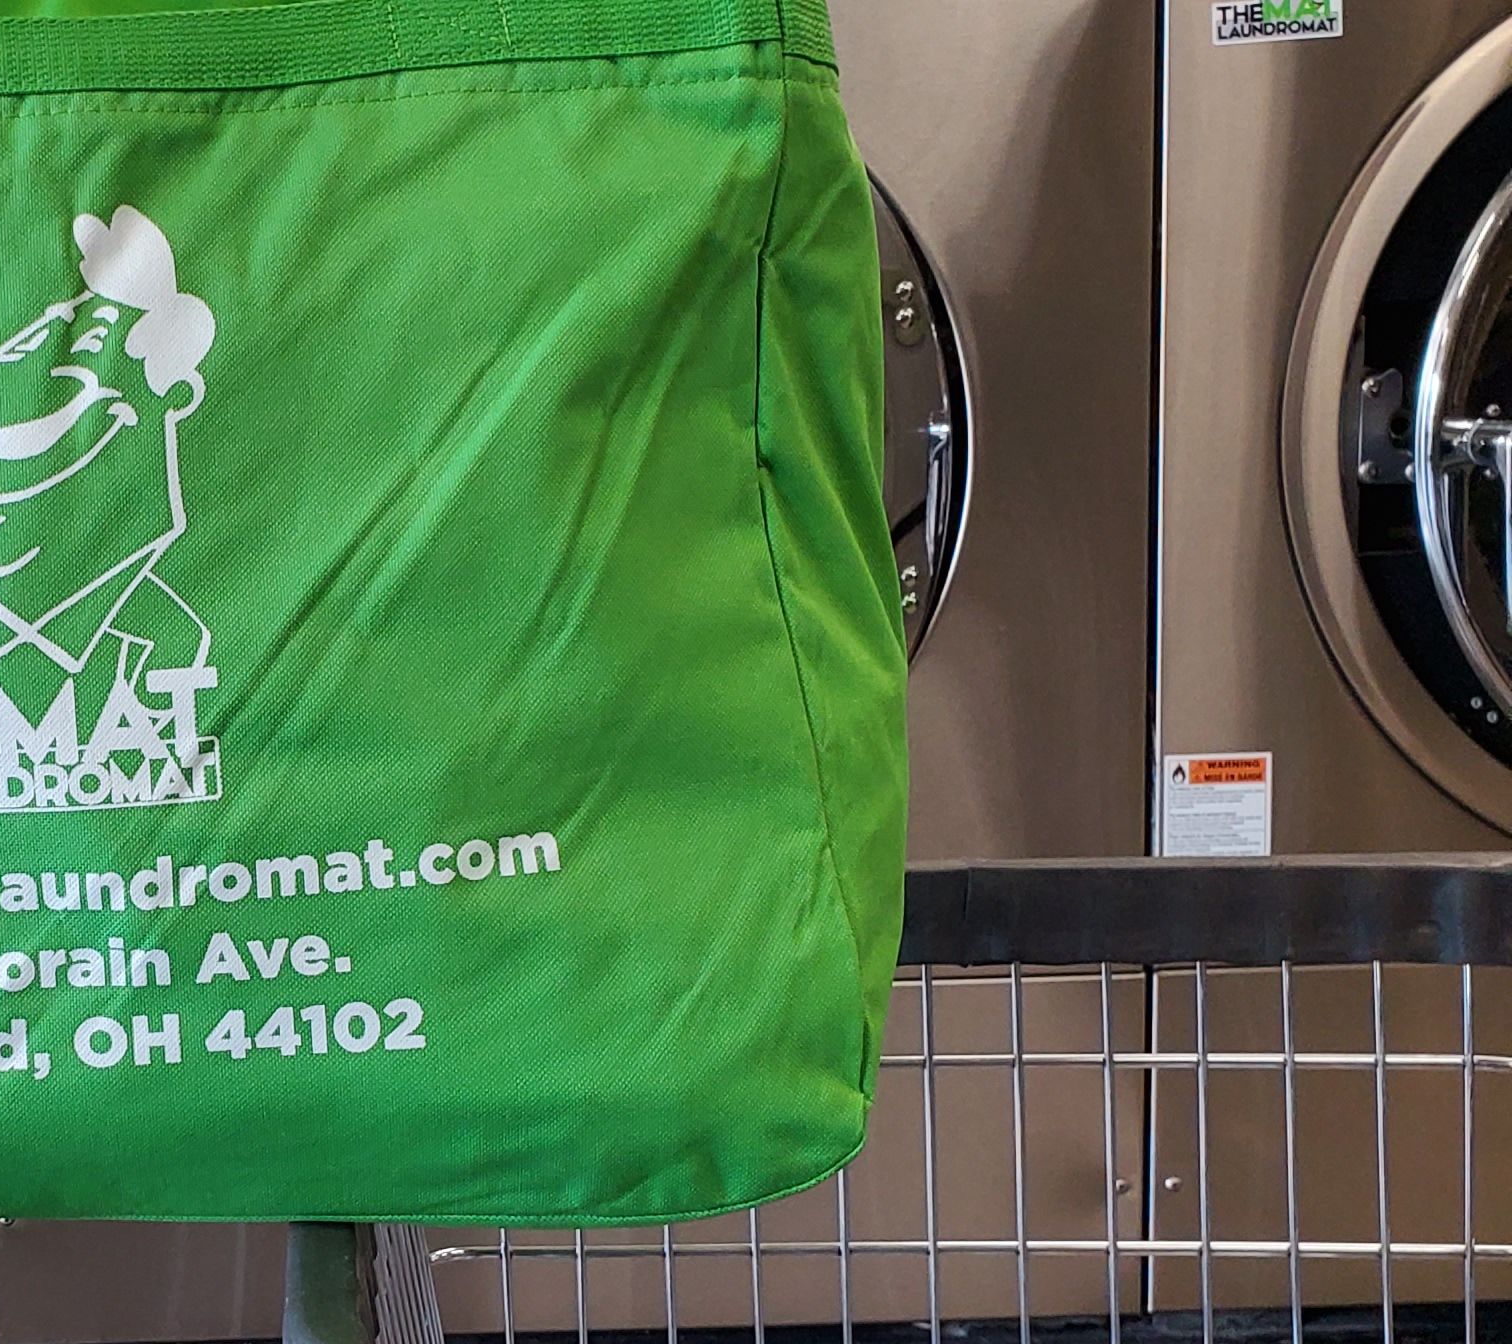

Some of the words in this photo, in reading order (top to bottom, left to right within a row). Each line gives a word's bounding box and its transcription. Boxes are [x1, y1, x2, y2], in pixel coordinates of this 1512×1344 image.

[1216, 3, 1263, 25] THE
[1217, 17, 1337, 39] LAUNDROMAT
[1207, 759, 1261, 769] WARNING
[195, 932, 353, 984] Ave.
[73, 1012, 182, 1069] OH
[205, 997, 427, 1060] 44102
